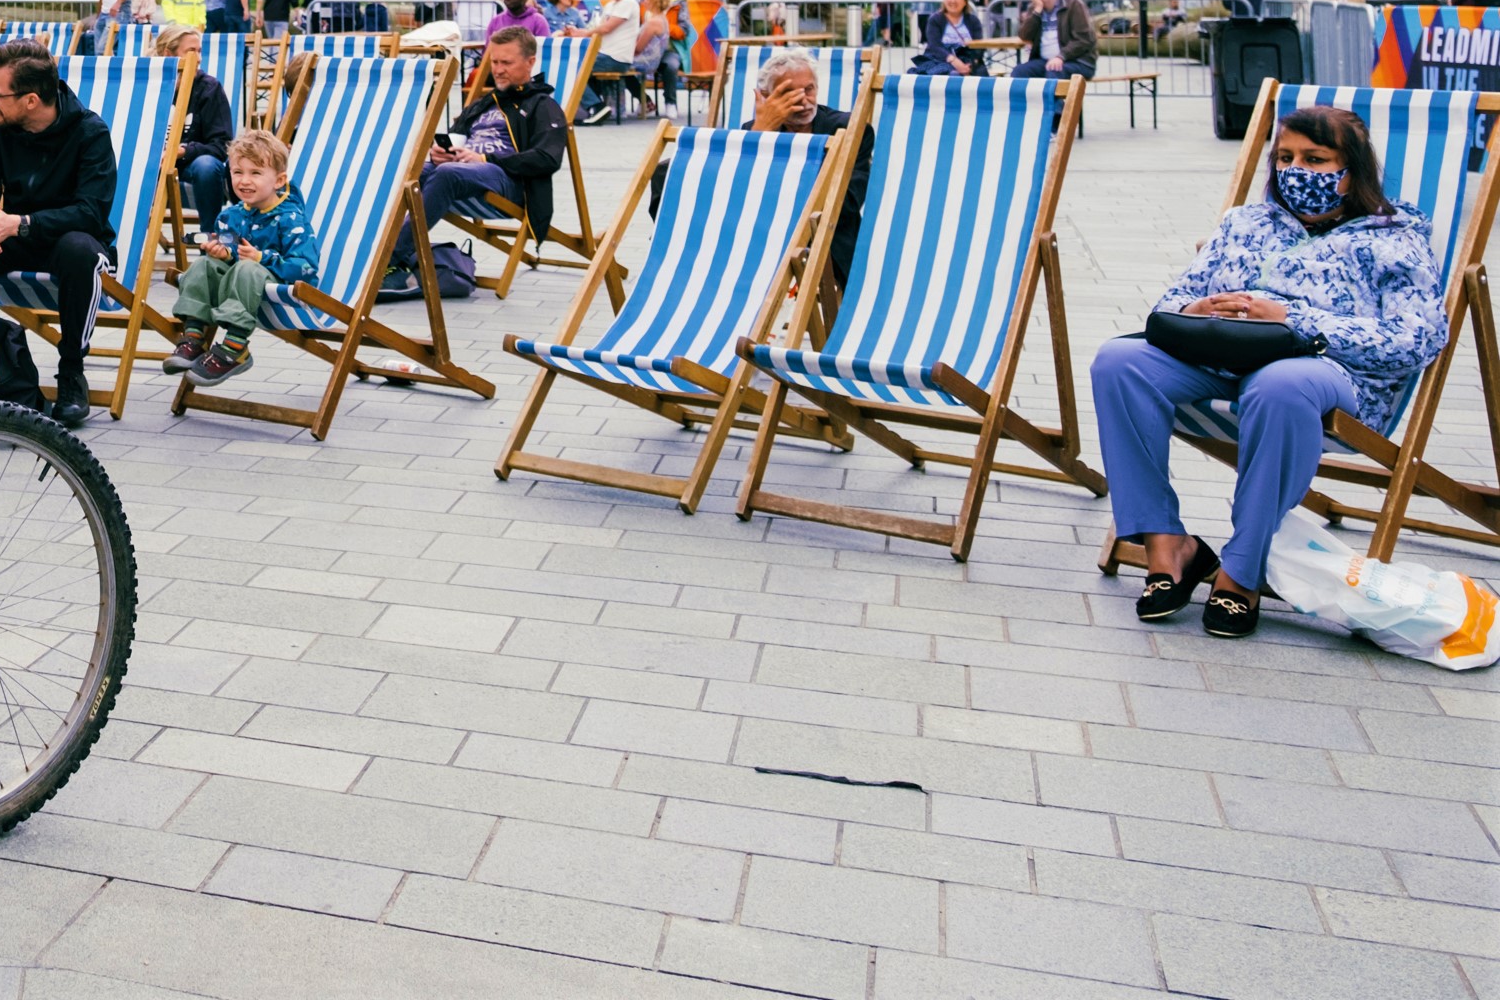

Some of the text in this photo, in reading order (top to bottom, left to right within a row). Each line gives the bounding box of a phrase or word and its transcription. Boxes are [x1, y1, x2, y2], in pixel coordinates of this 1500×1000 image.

[1421, 26, 1500, 67] LEADMI
[1422, 66, 1480, 92] IN THE
[91, 679, 108, 717] KENDA
